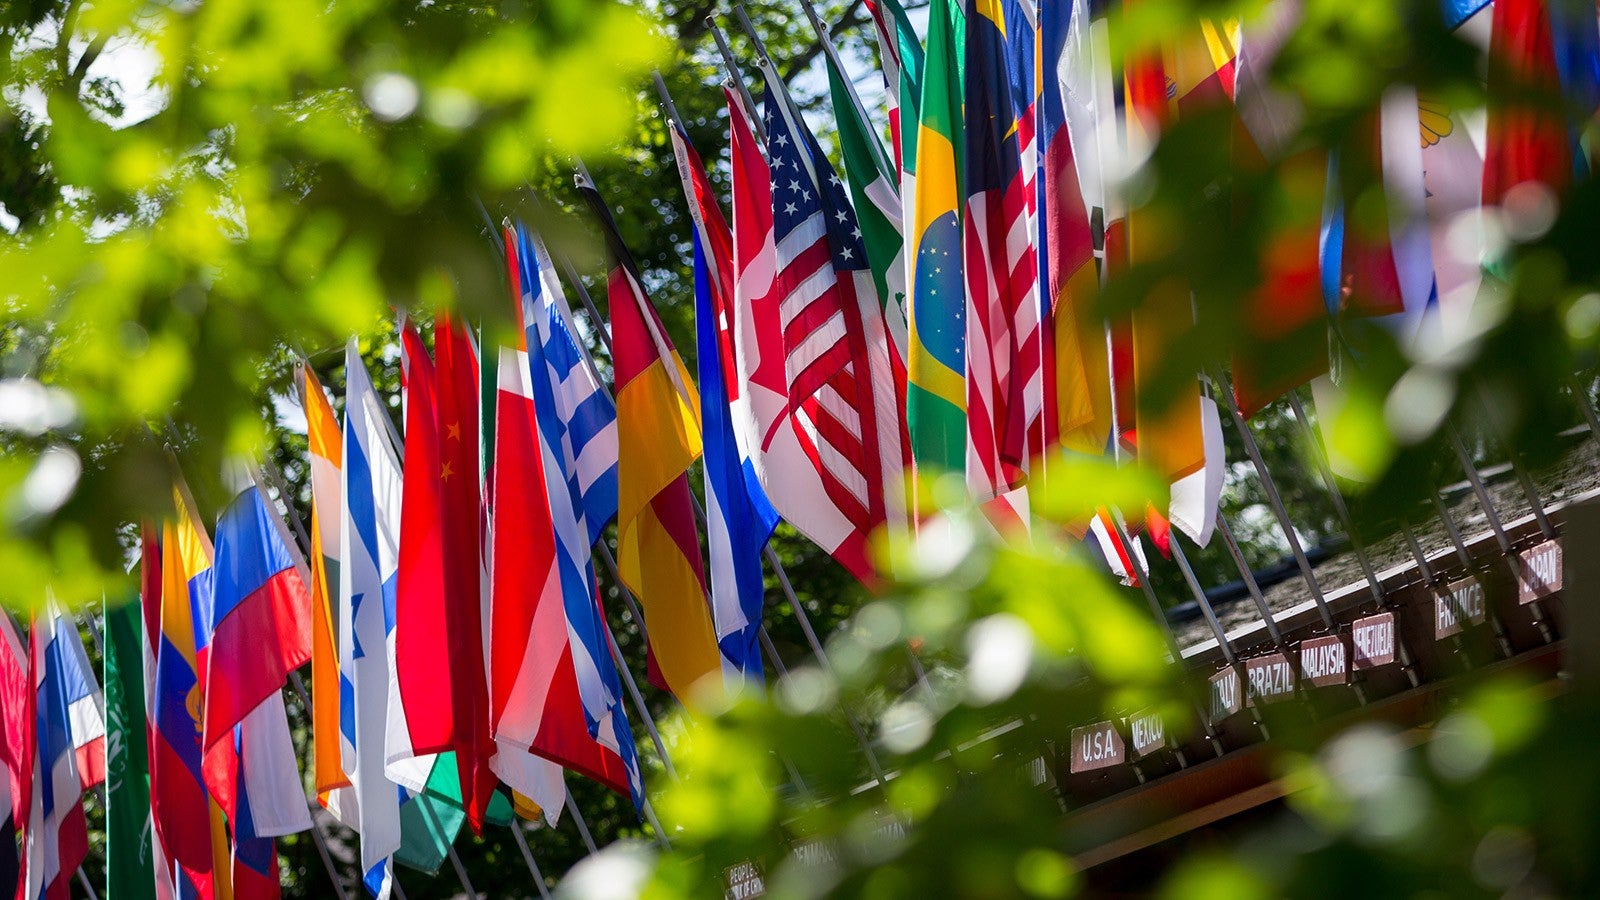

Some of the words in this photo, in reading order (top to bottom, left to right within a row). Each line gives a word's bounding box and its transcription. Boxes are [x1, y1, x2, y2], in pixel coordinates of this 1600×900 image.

[1523, 546, 1557, 593] JAPAN
[1438, 583, 1482, 630] FRANCE
[1301, 642, 1347, 679] MALAYSIA
[1211, 671, 1236, 716] ITALY
[1248, 661, 1293, 699] BRAZIL
[1083, 729, 1117, 762] U.S.A.
[1131, 714, 1163, 752] MEXICO
